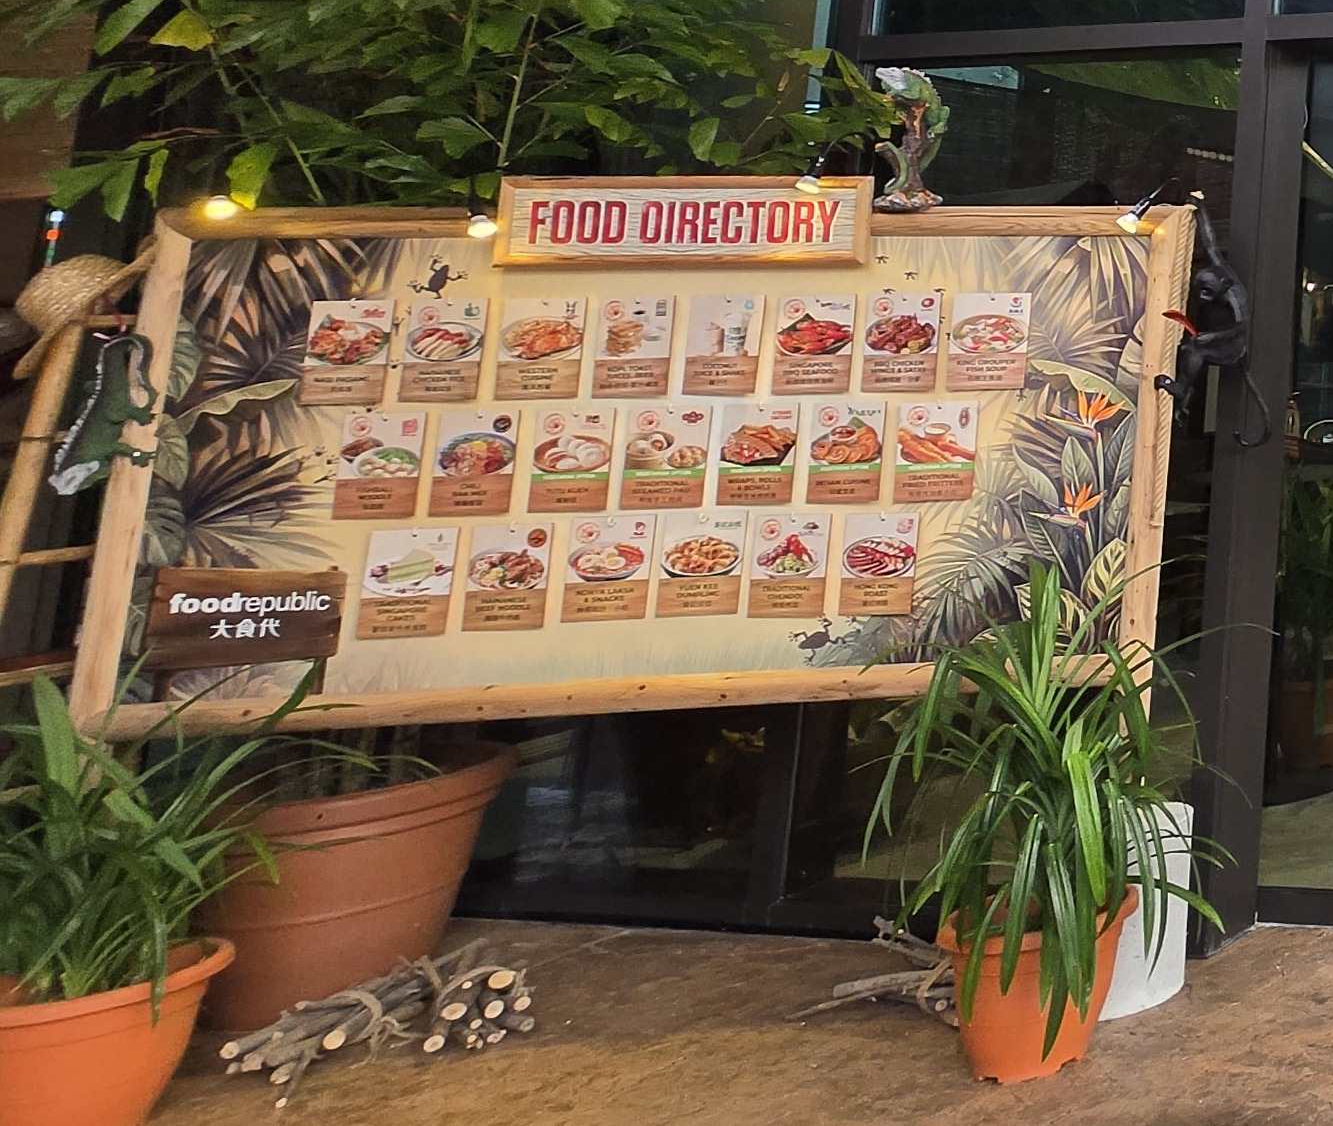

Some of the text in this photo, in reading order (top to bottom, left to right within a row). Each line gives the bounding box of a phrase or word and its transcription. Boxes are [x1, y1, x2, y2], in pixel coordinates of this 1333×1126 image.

[528, 199, 841, 245] FOOD DIRECTORY
[169, 590, 331, 617] foodrepublic
[209, 618, 282, 640] 大食代
